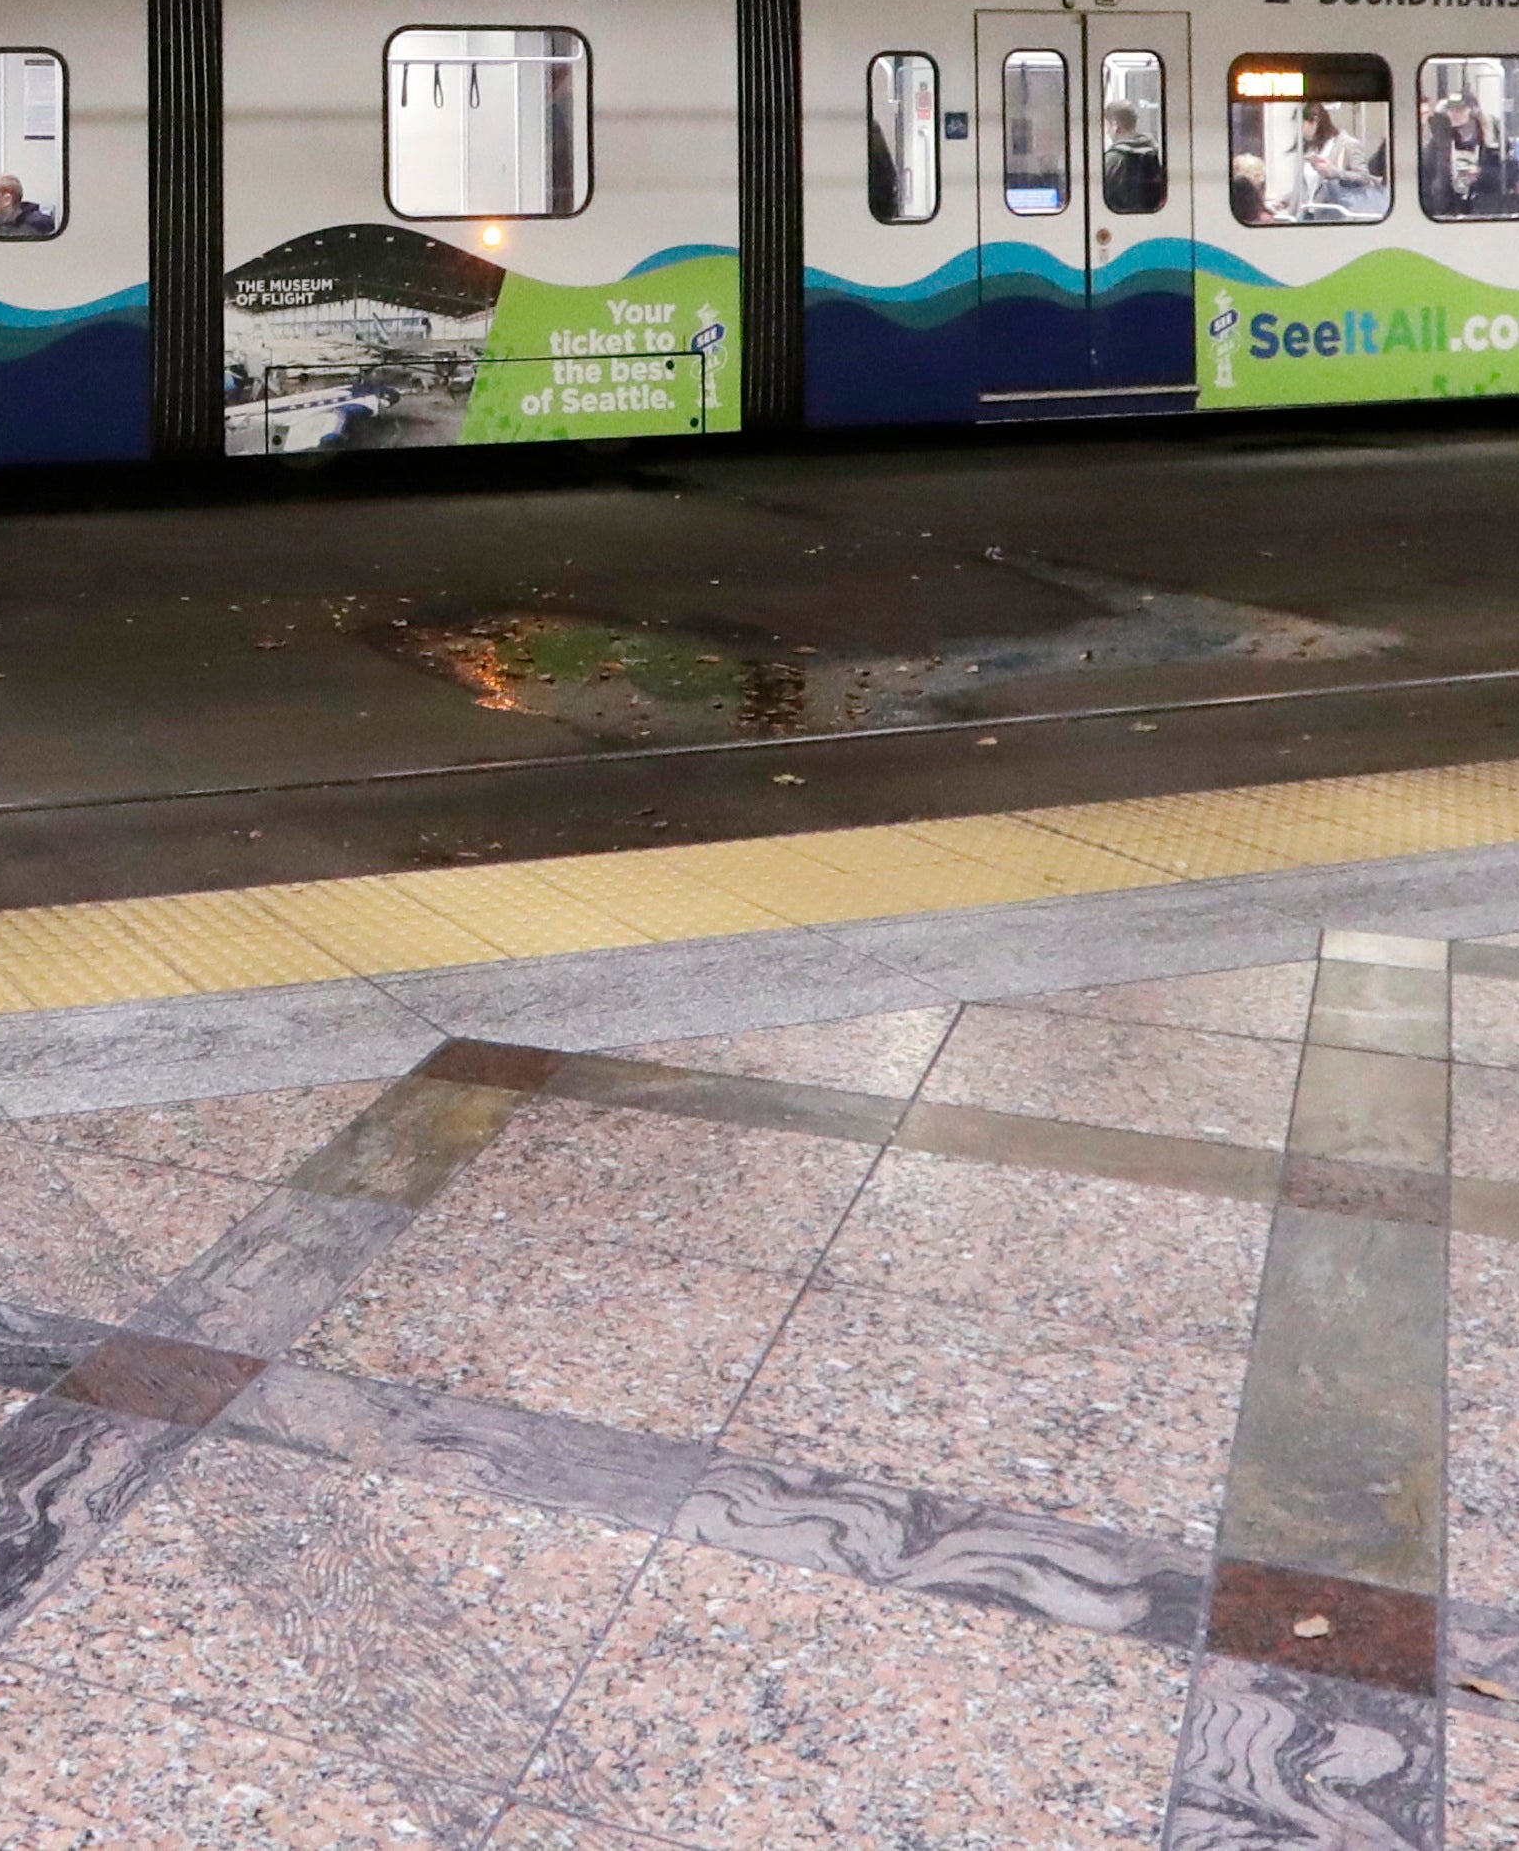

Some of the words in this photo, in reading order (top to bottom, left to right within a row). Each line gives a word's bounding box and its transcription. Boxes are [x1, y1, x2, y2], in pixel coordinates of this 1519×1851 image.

[235, 280, 265, 293] THE
[269, 278, 334, 293] MUSEUM
[236, 293, 258, 306] OF
[261, 291, 315, 305] FLIGHT
[607, 299, 677, 325] Your
[550, 328, 636, 356] ticket
[644, 328, 676, 354] to
[552, 357, 603, 386] the
[611, 356, 676, 383] best
[520, 386, 554, 416] of
[560, 383, 677, 414] Seattle.
